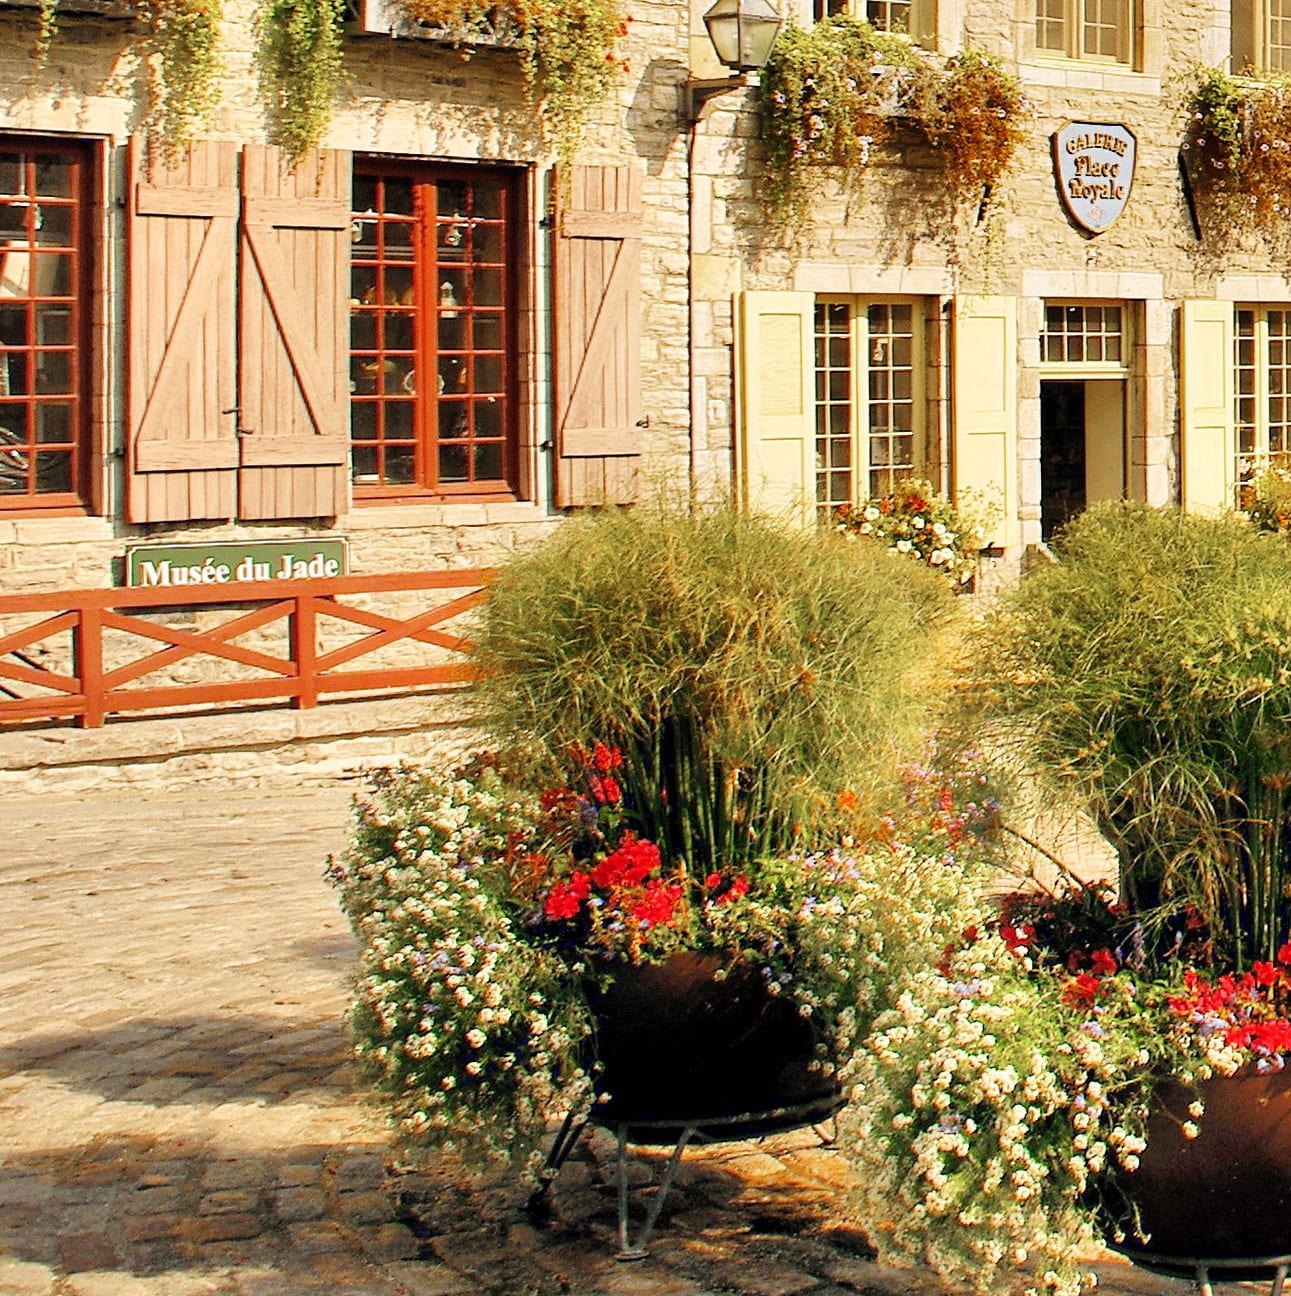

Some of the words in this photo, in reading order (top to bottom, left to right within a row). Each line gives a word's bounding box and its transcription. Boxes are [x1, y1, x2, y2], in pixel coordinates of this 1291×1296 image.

[1066, 132, 1128, 157] GALERIE
[1074, 155, 1119, 177] Place
[1068, 177, 1124, 204] Royale
[139, 557, 231, 587] Musée
[235, 556, 272, 582] du
[276, 552, 340, 580] Jade
